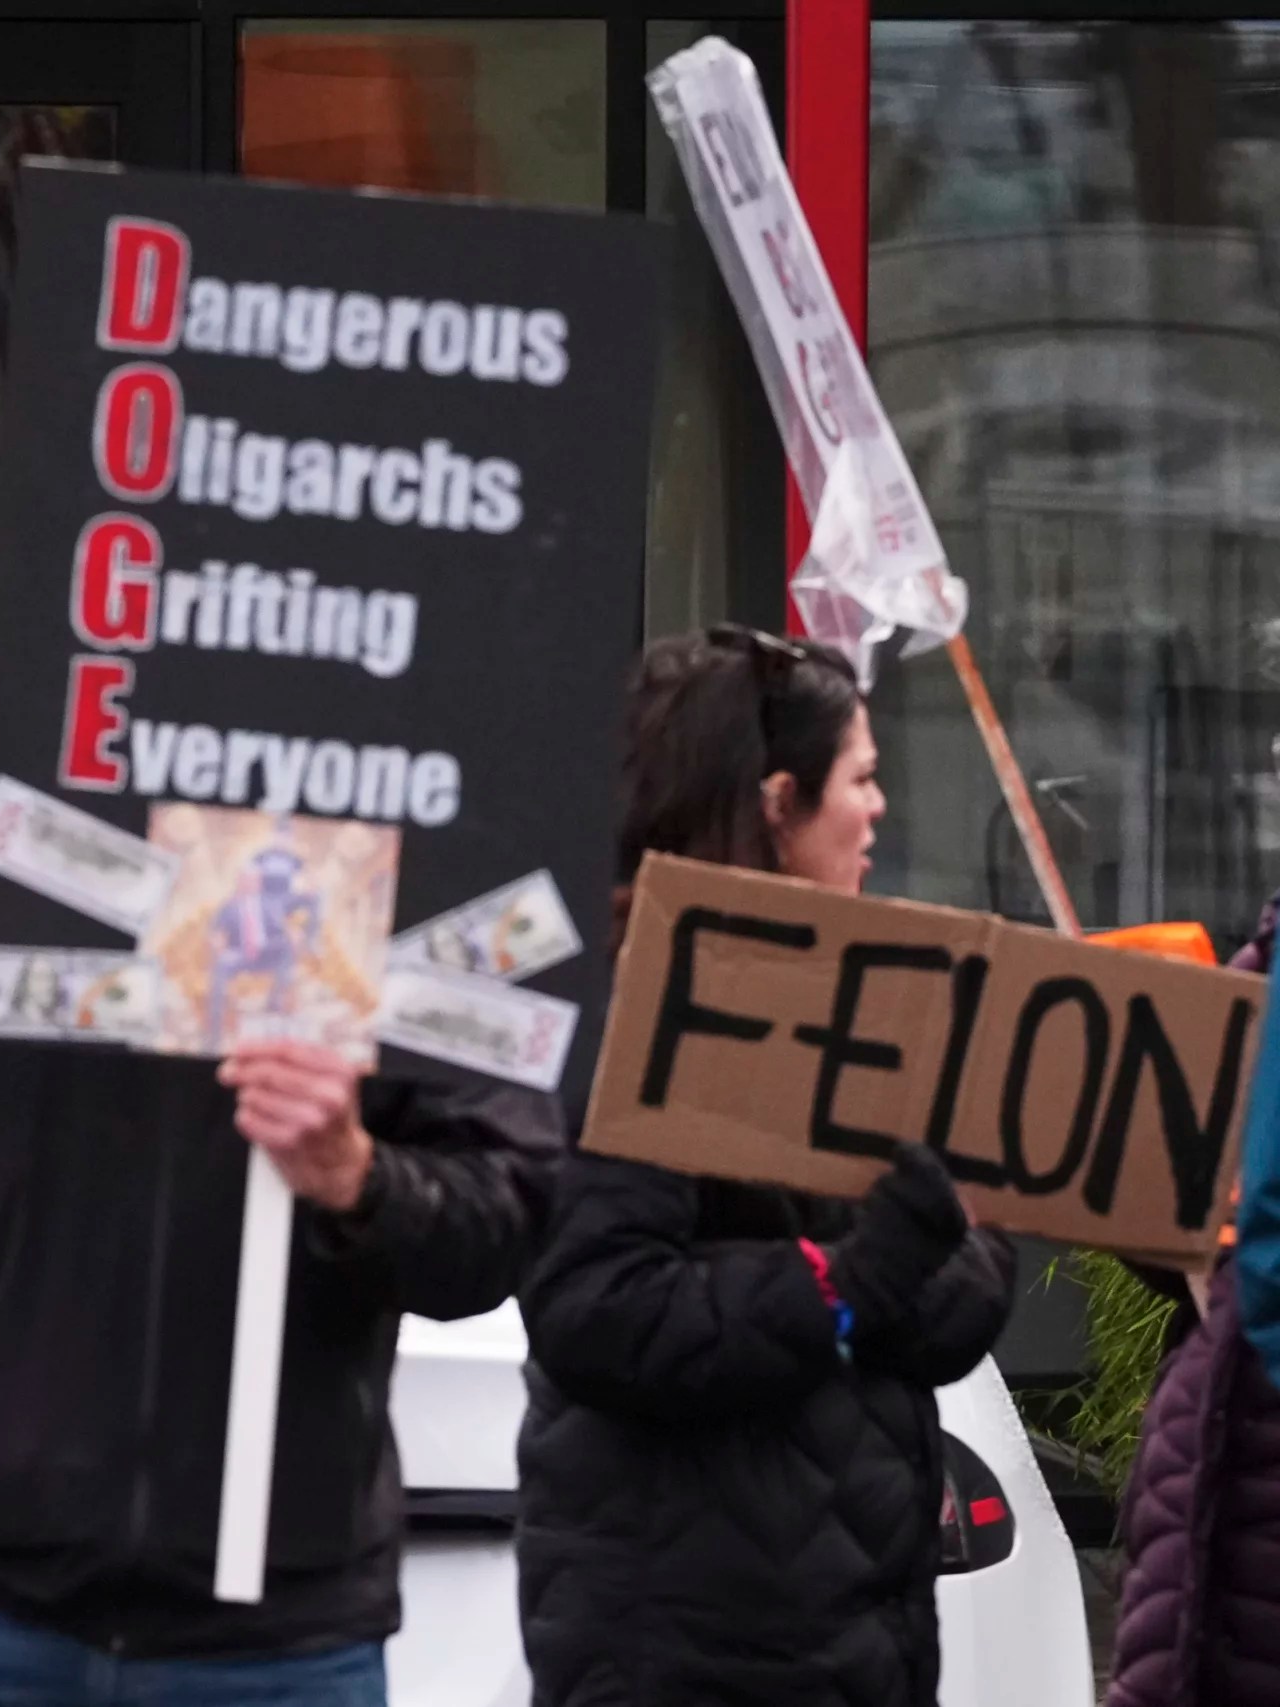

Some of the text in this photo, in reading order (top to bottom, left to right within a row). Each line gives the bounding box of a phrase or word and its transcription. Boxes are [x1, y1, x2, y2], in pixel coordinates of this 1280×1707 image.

[97, 215, 569, 387] Dangerous
[92, 361, 522, 534] Oligarchs
[70, 512, 418, 678] Grifting
[57, 655, 461, 827] Everyone
[640, 907, 1259, 1231] FELON
